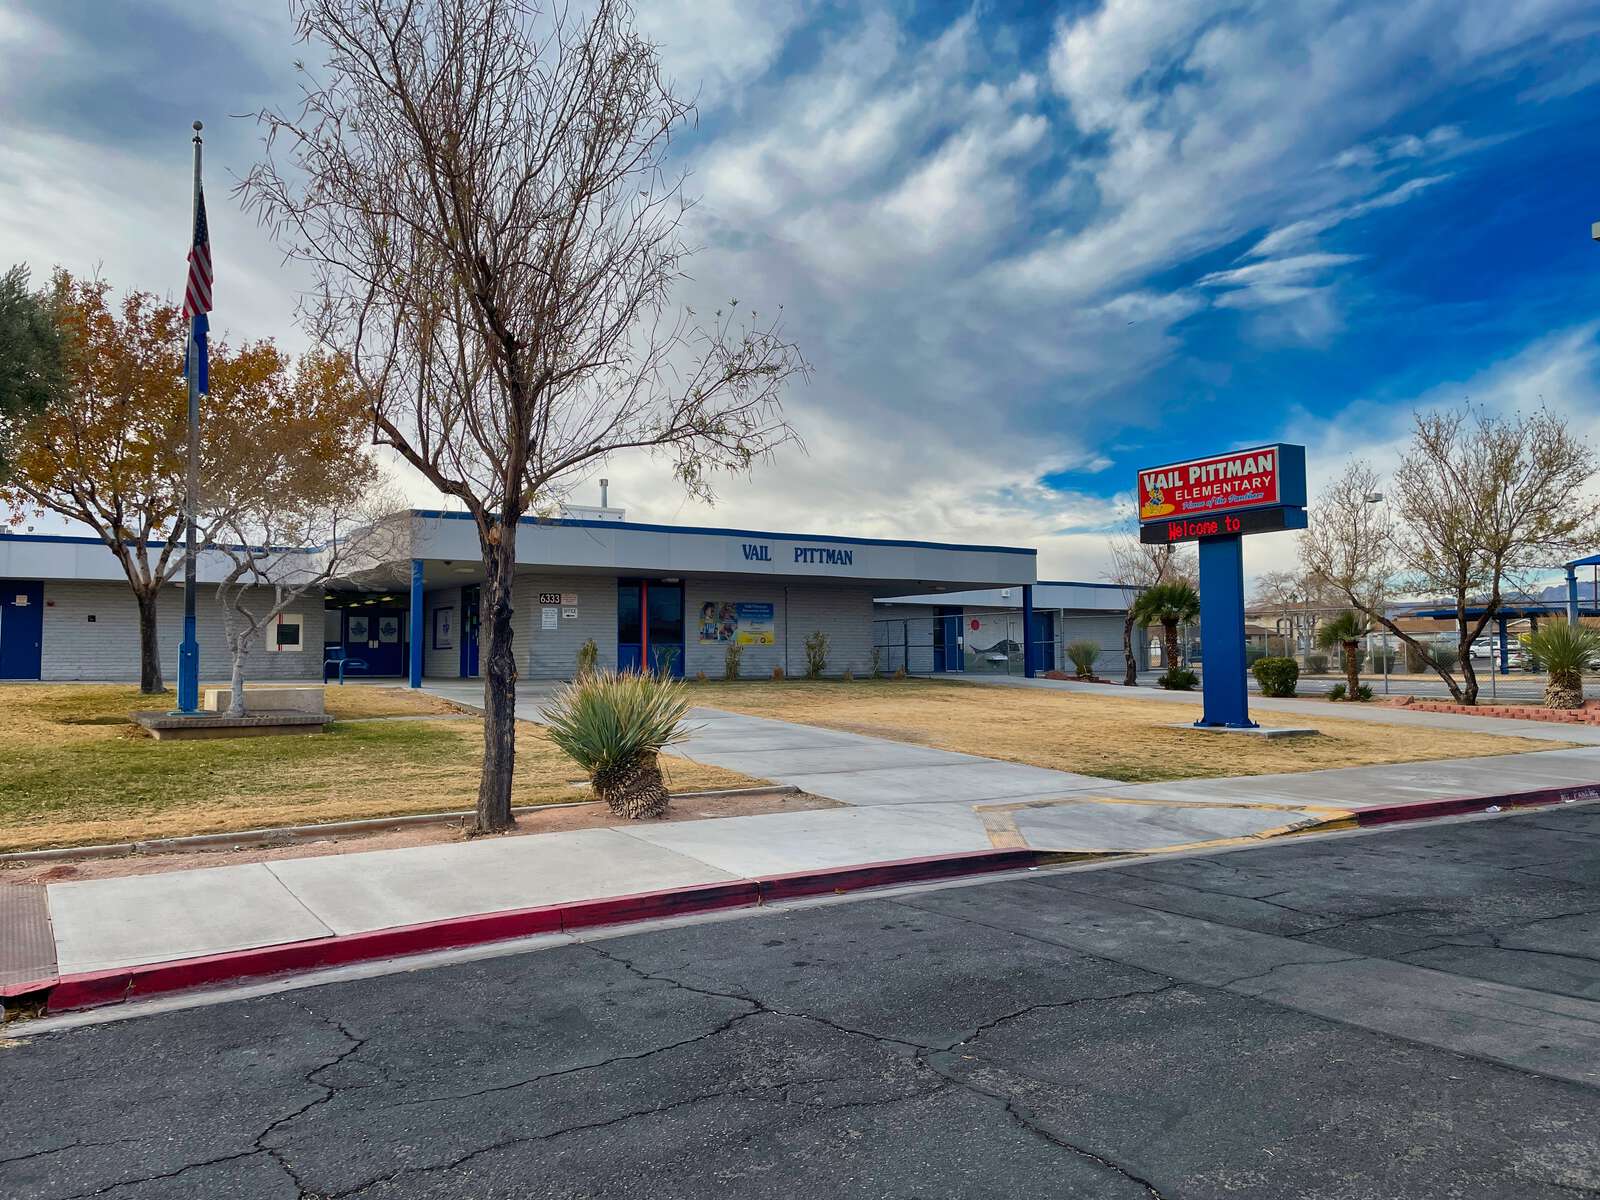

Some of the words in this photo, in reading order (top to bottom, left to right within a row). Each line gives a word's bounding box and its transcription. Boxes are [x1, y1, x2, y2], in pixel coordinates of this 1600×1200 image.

[1143, 472, 1183, 491] VAIL
[1189, 454, 1273, 484] PITTMAN
[1175, 476, 1271, 500] ELEMENTARY
[1168, 522, 1218, 540] Welcome
[1225, 516, 1240, 531] to
[742, 544, 771, 561] VAIL
[794, 547, 853, 565] PITTMAN
[540, 594, 560, 603] 6333
